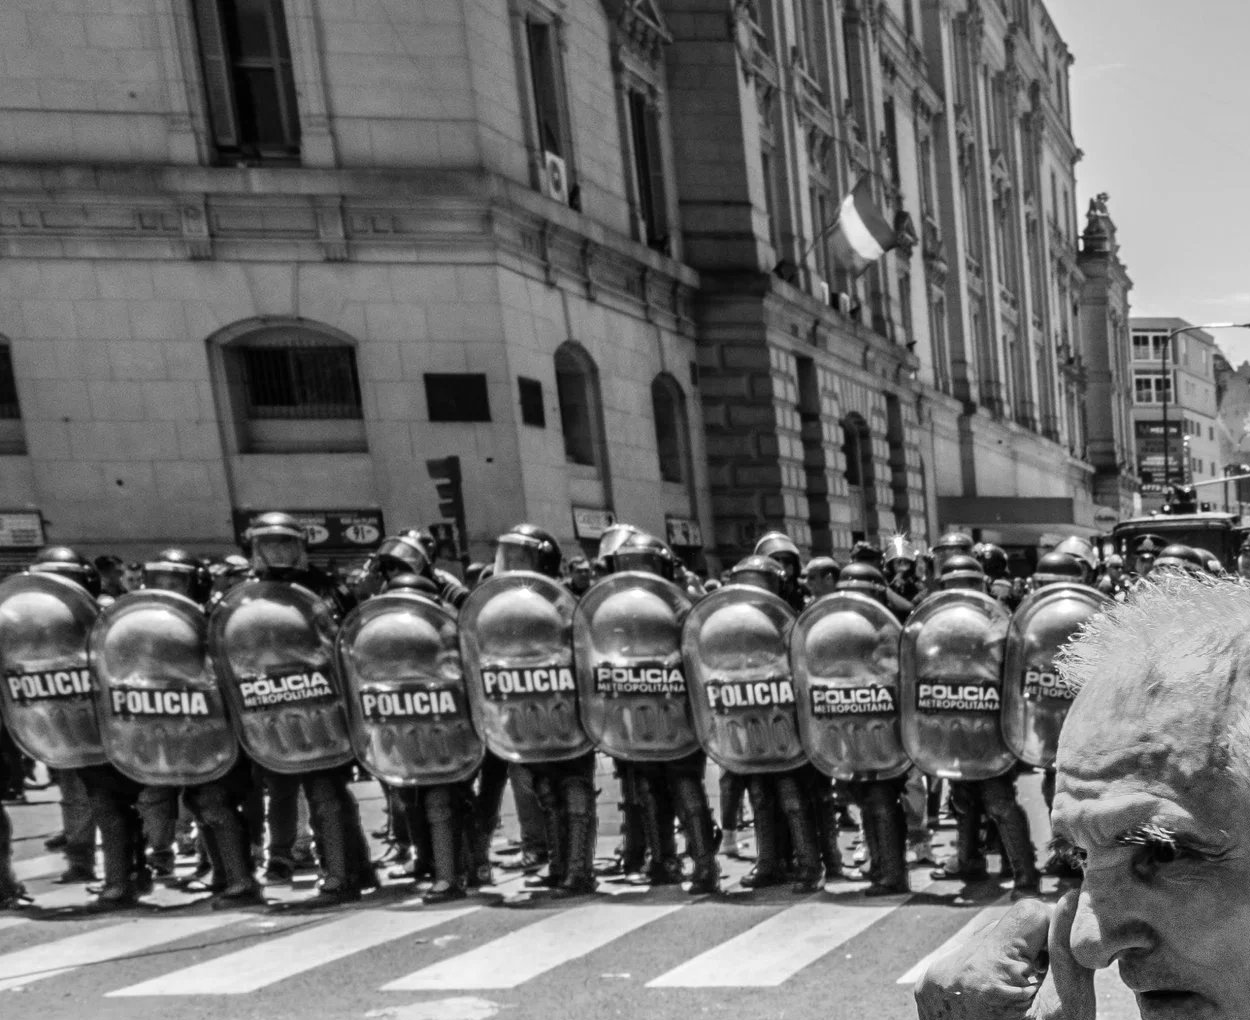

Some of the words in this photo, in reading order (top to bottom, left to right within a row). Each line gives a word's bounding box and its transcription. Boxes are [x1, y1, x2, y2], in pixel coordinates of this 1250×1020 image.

[240, 671, 328, 698] POLICIA
[483, 668, 575, 694] POLICIA
[597, 667, 684, 683] POLICIA
[244, 686, 333, 708] METROPOLITANA
[597, 682, 686, 693] METROPOLITANA
[707, 681, 794, 708] POLICIA
[813, 688, 893, 704] POLICIA
[919, 683, 999, 701] POLICIA
[113, 690, 209, 716] POLICIA
[362, 691, 456, 717] POLICIA
[814, 702, 895, 714] METROPOLITANA
[918, 699, 1000, 711] METROPOLITANA
